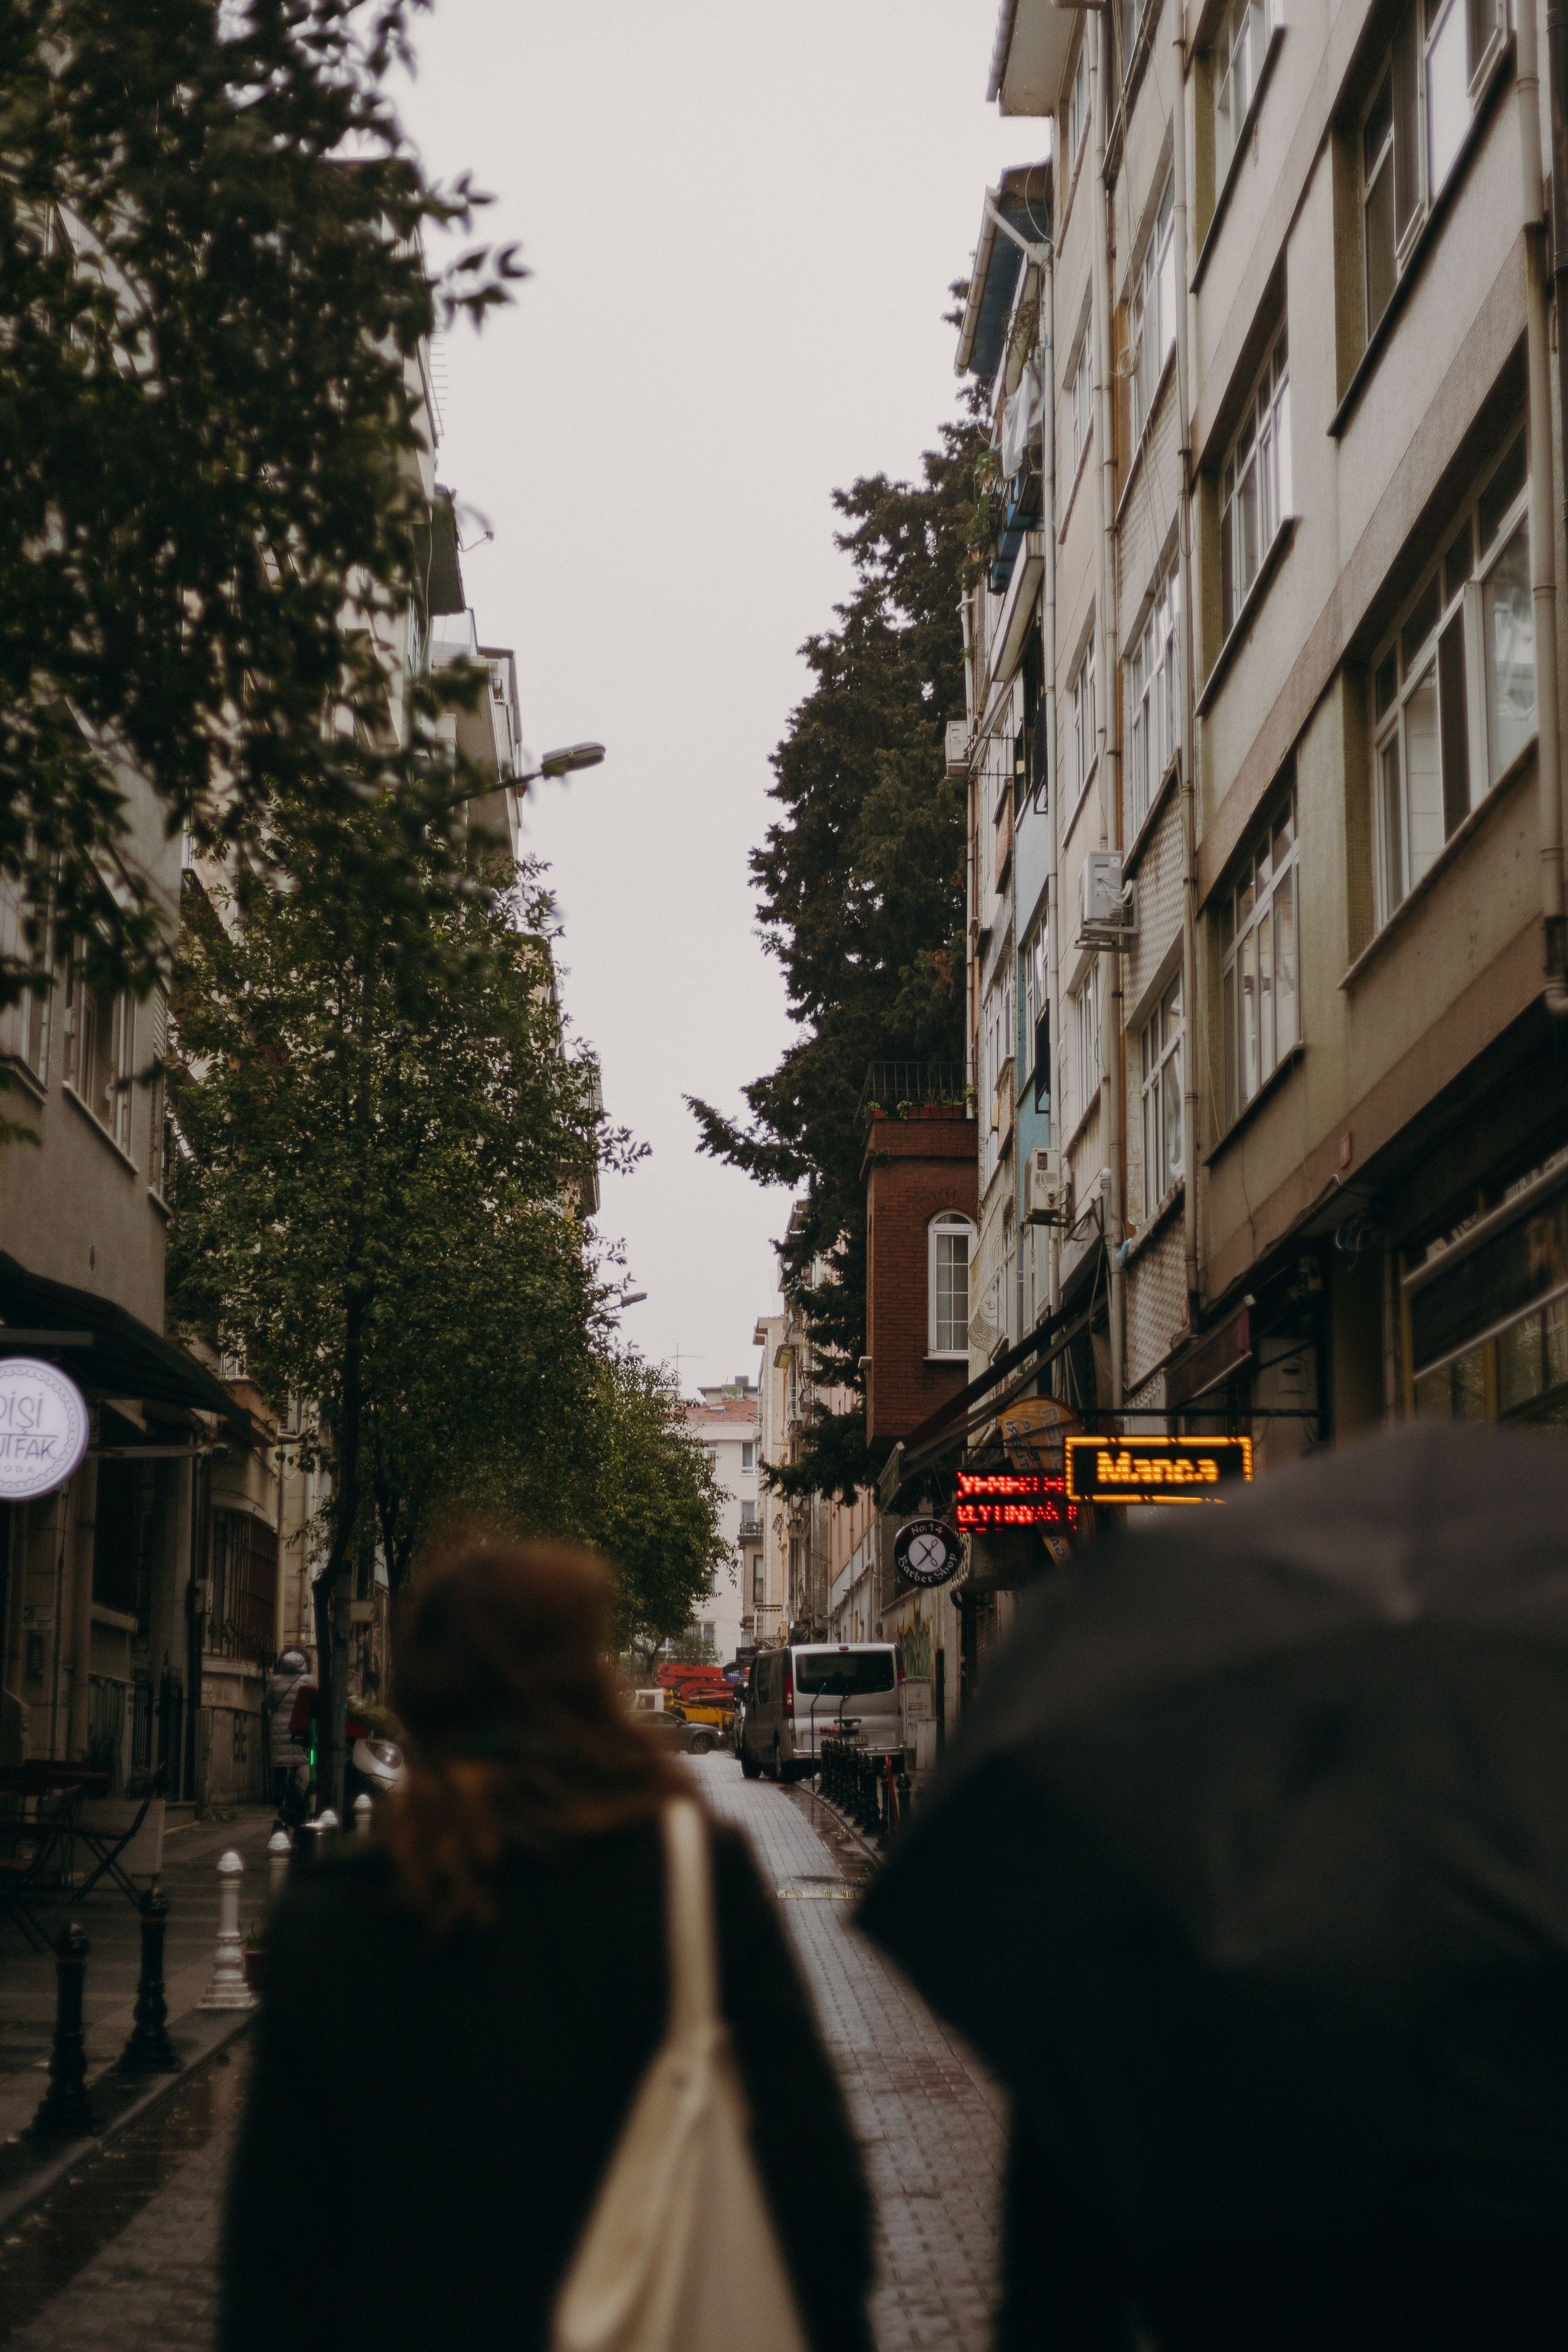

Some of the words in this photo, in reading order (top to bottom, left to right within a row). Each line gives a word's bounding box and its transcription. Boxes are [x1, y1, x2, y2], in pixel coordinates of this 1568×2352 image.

[911, 1523, 943, 1535] No:14
[898, 1554, 933, 1583] Barber
[933, 1553, 957, 1580] Shop
